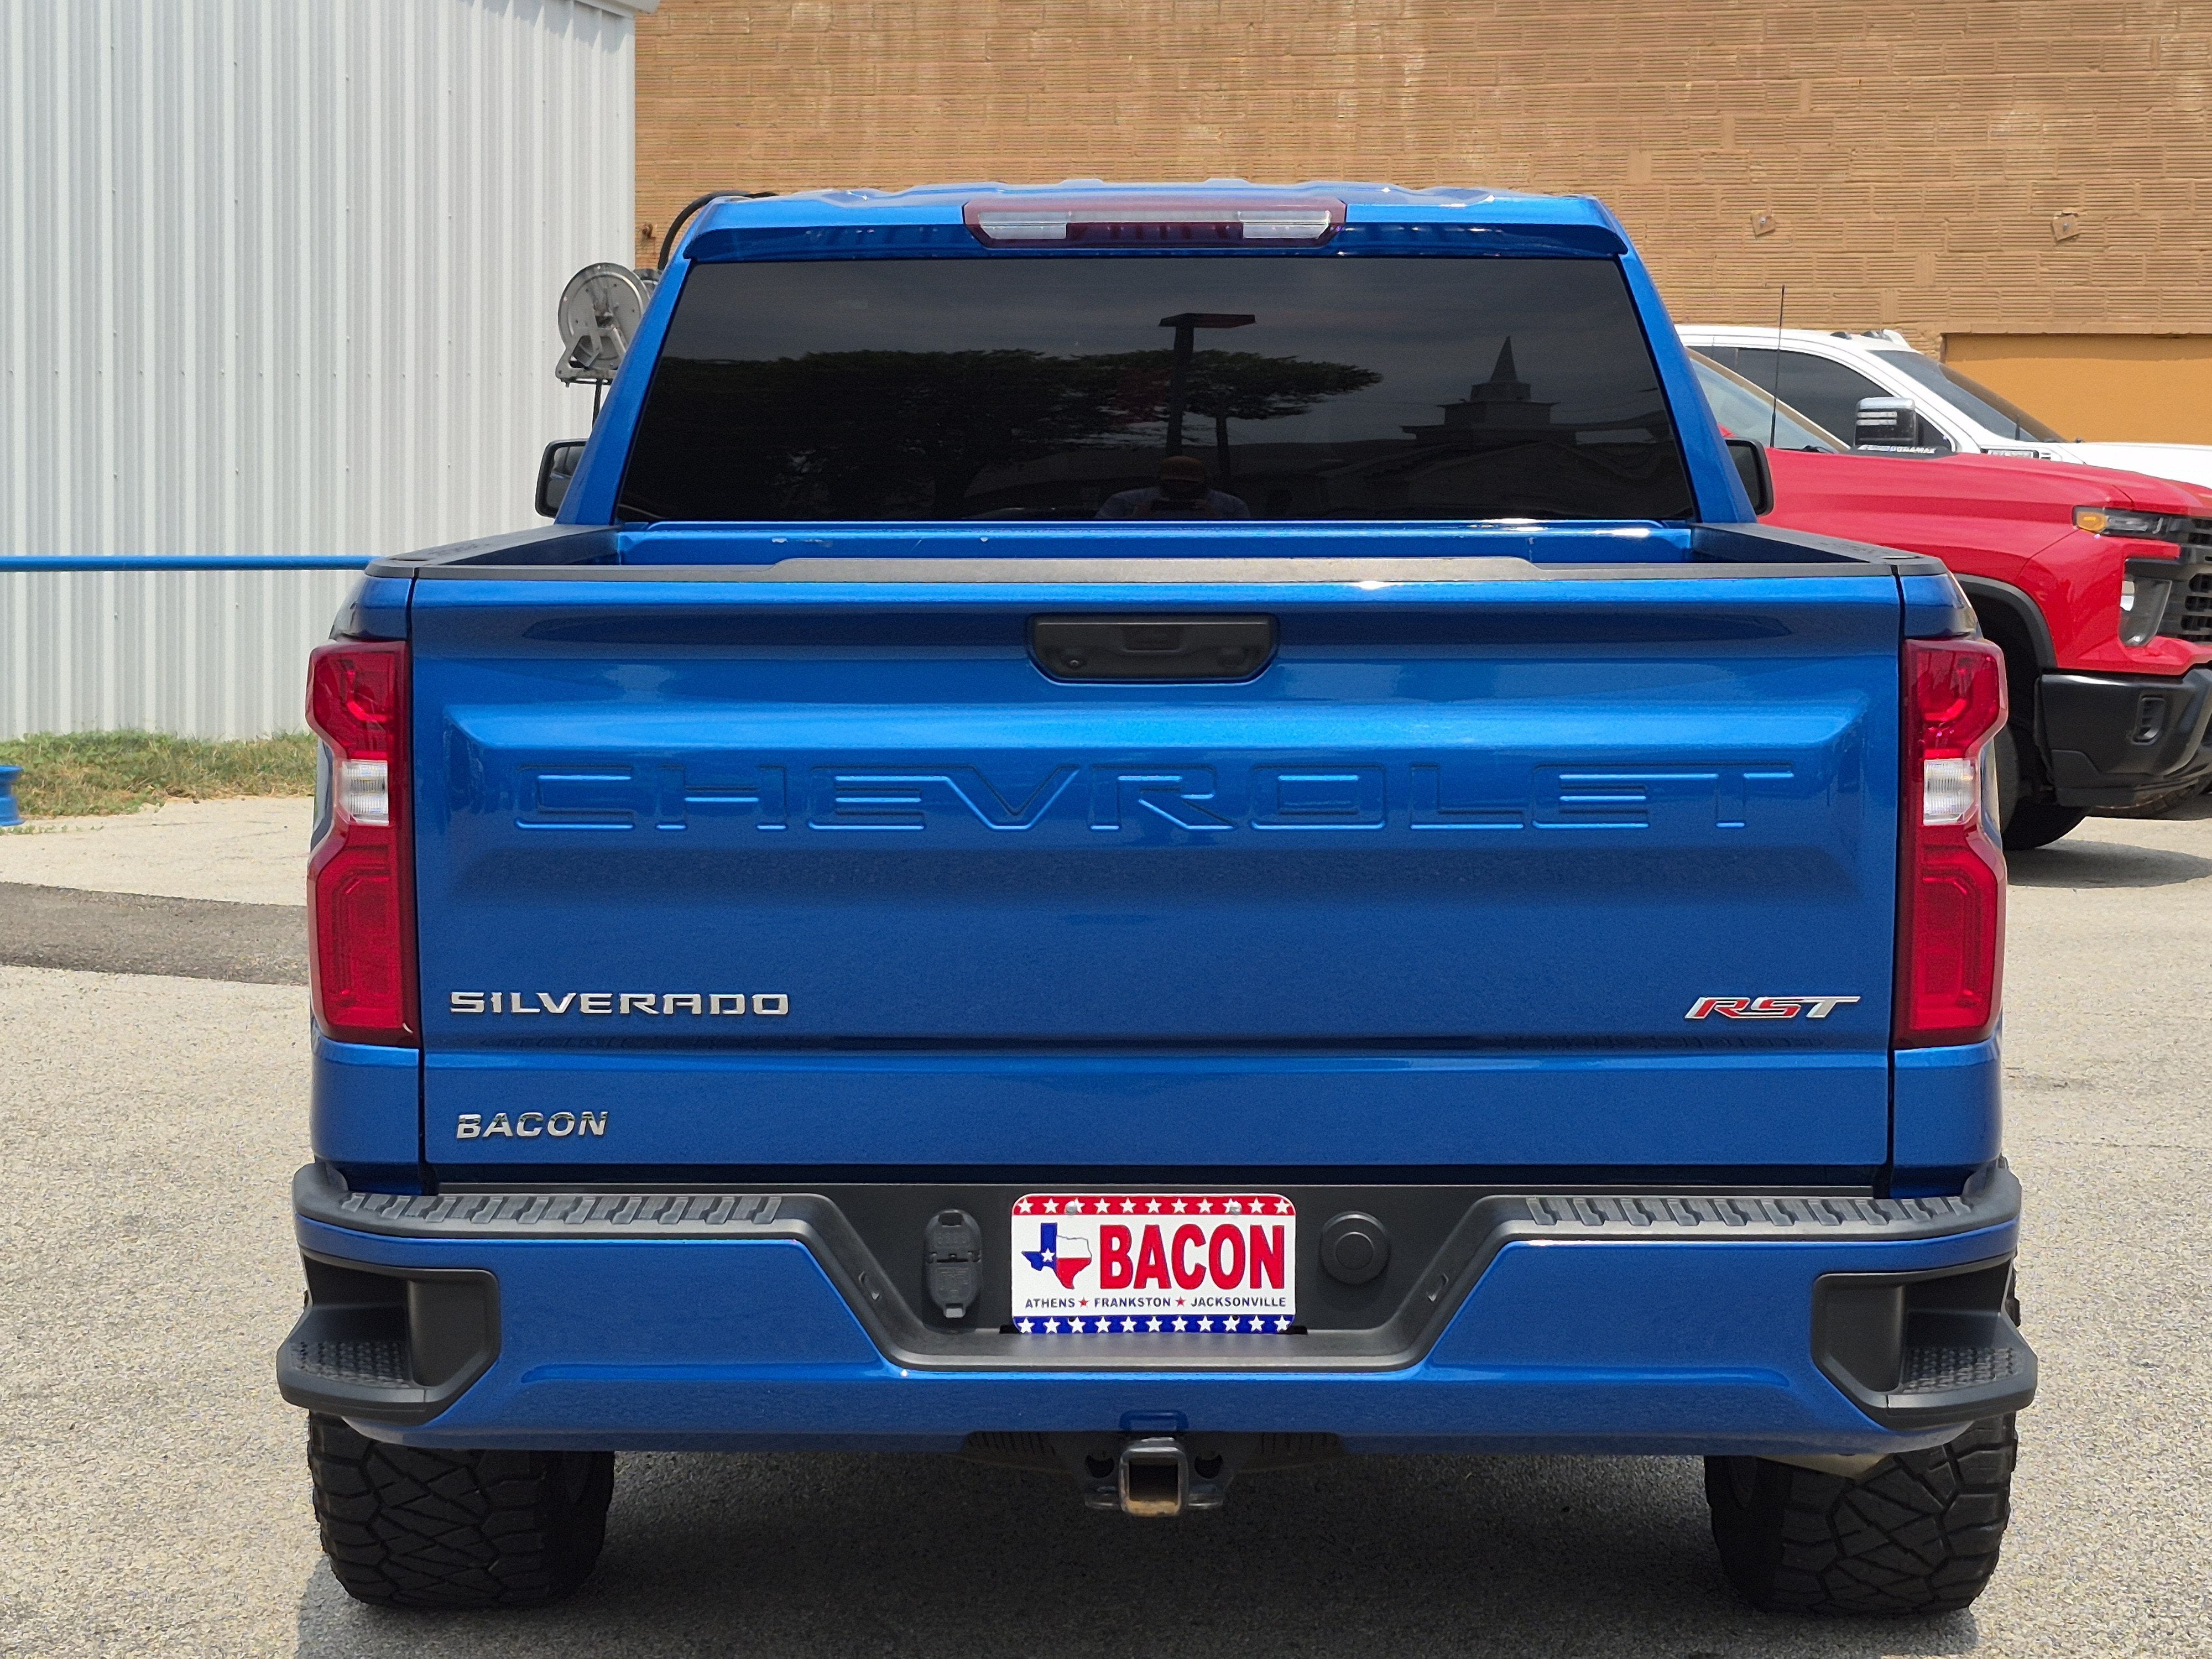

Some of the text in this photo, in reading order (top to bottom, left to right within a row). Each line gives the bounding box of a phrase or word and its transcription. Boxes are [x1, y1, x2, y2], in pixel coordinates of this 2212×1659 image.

[515, 764, 1794, 831] CHEVROLET
[450, 991, 789, 1015] SILVERADO
[1684, 996, 1861, 1019] RST
[456, 1110, 608, 1139] BACON
[1099, 1223, 1285, 1290] BACON
[1025, 1297, 1286, 1308] ATHENS FRANKSTON JACKSONVILLE
